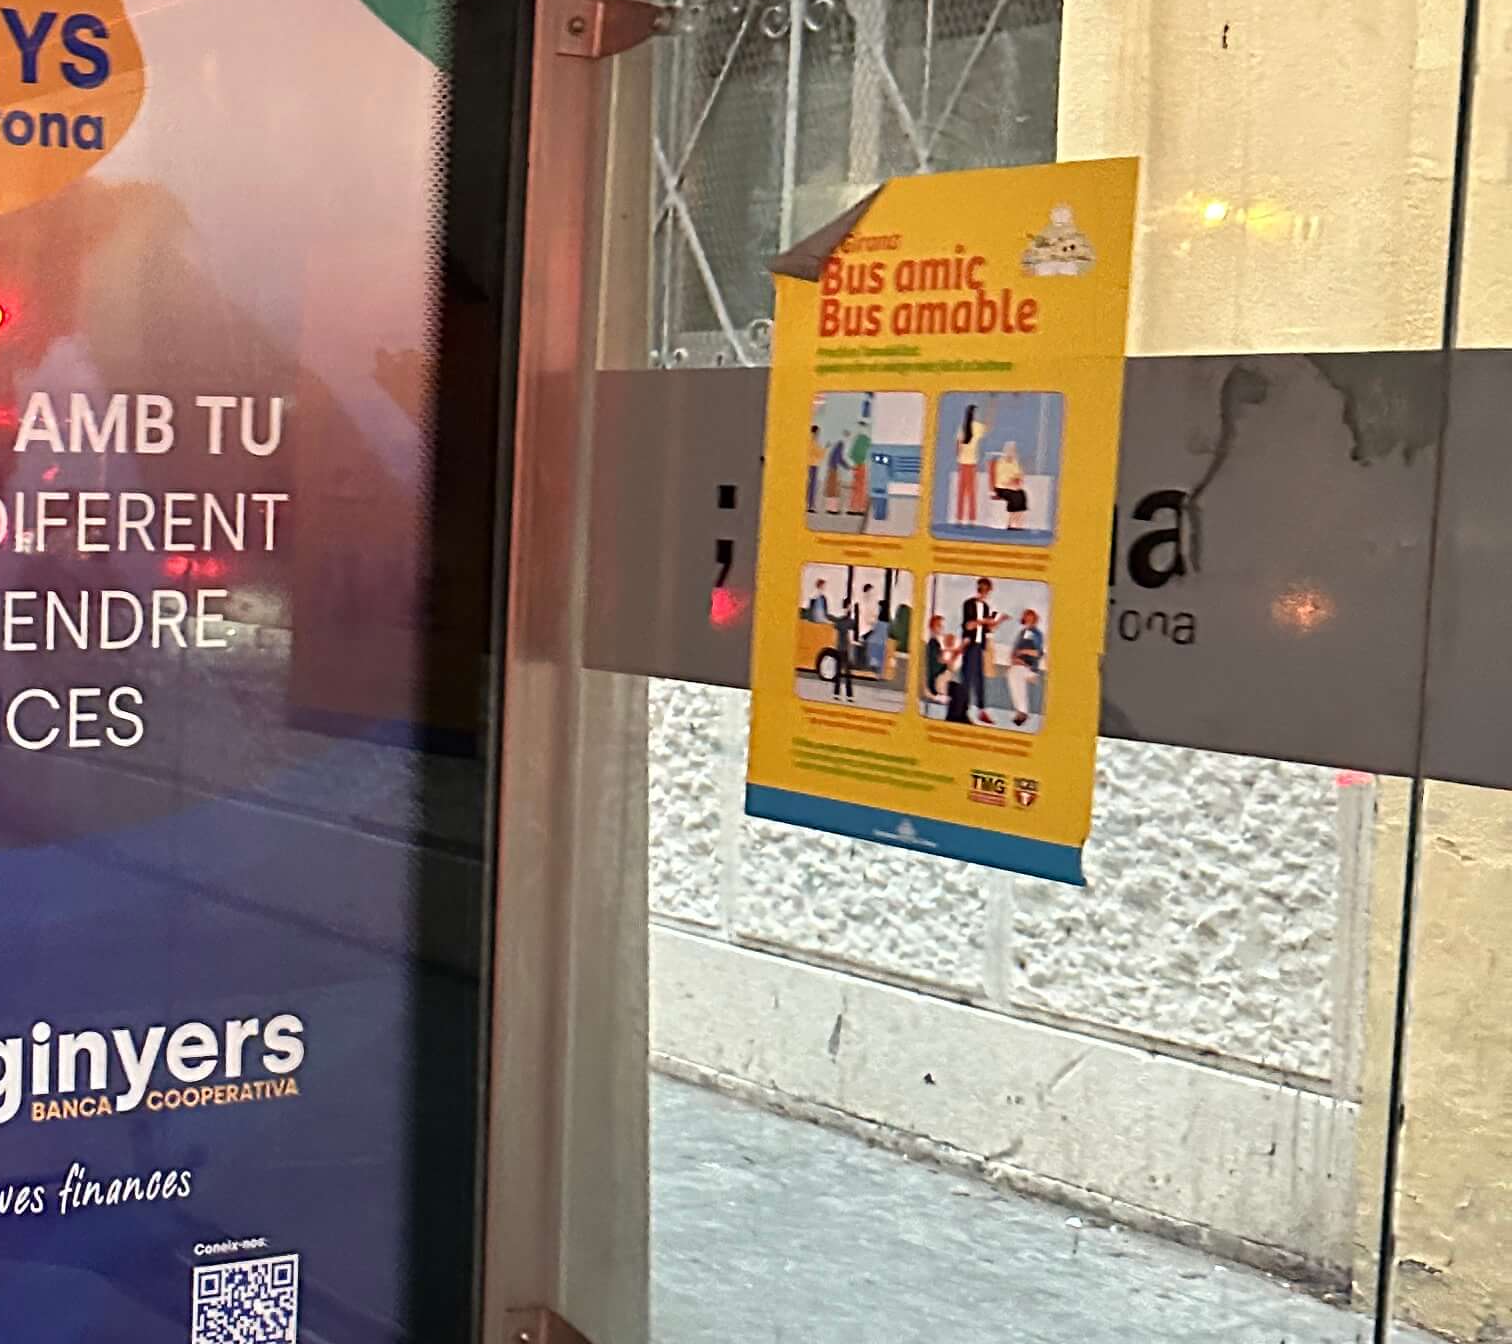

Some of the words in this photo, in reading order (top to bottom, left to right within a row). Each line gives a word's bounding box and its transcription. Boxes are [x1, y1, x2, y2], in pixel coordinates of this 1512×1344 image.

[822, 255, 886, 297] Bus
[894, 243, 987, 293] amic
[818, 298, 883, 338] Bus
[891, 288, 1040, 336] amable
[13, 391, 176, 454] AMB
[195, 394, 287, 458] TU
[31, 1097, 113, 1123] BANCA
[145, 1076, 300, 1111] COOPERATIVA
[58, 1162, 192, 1216] finances
